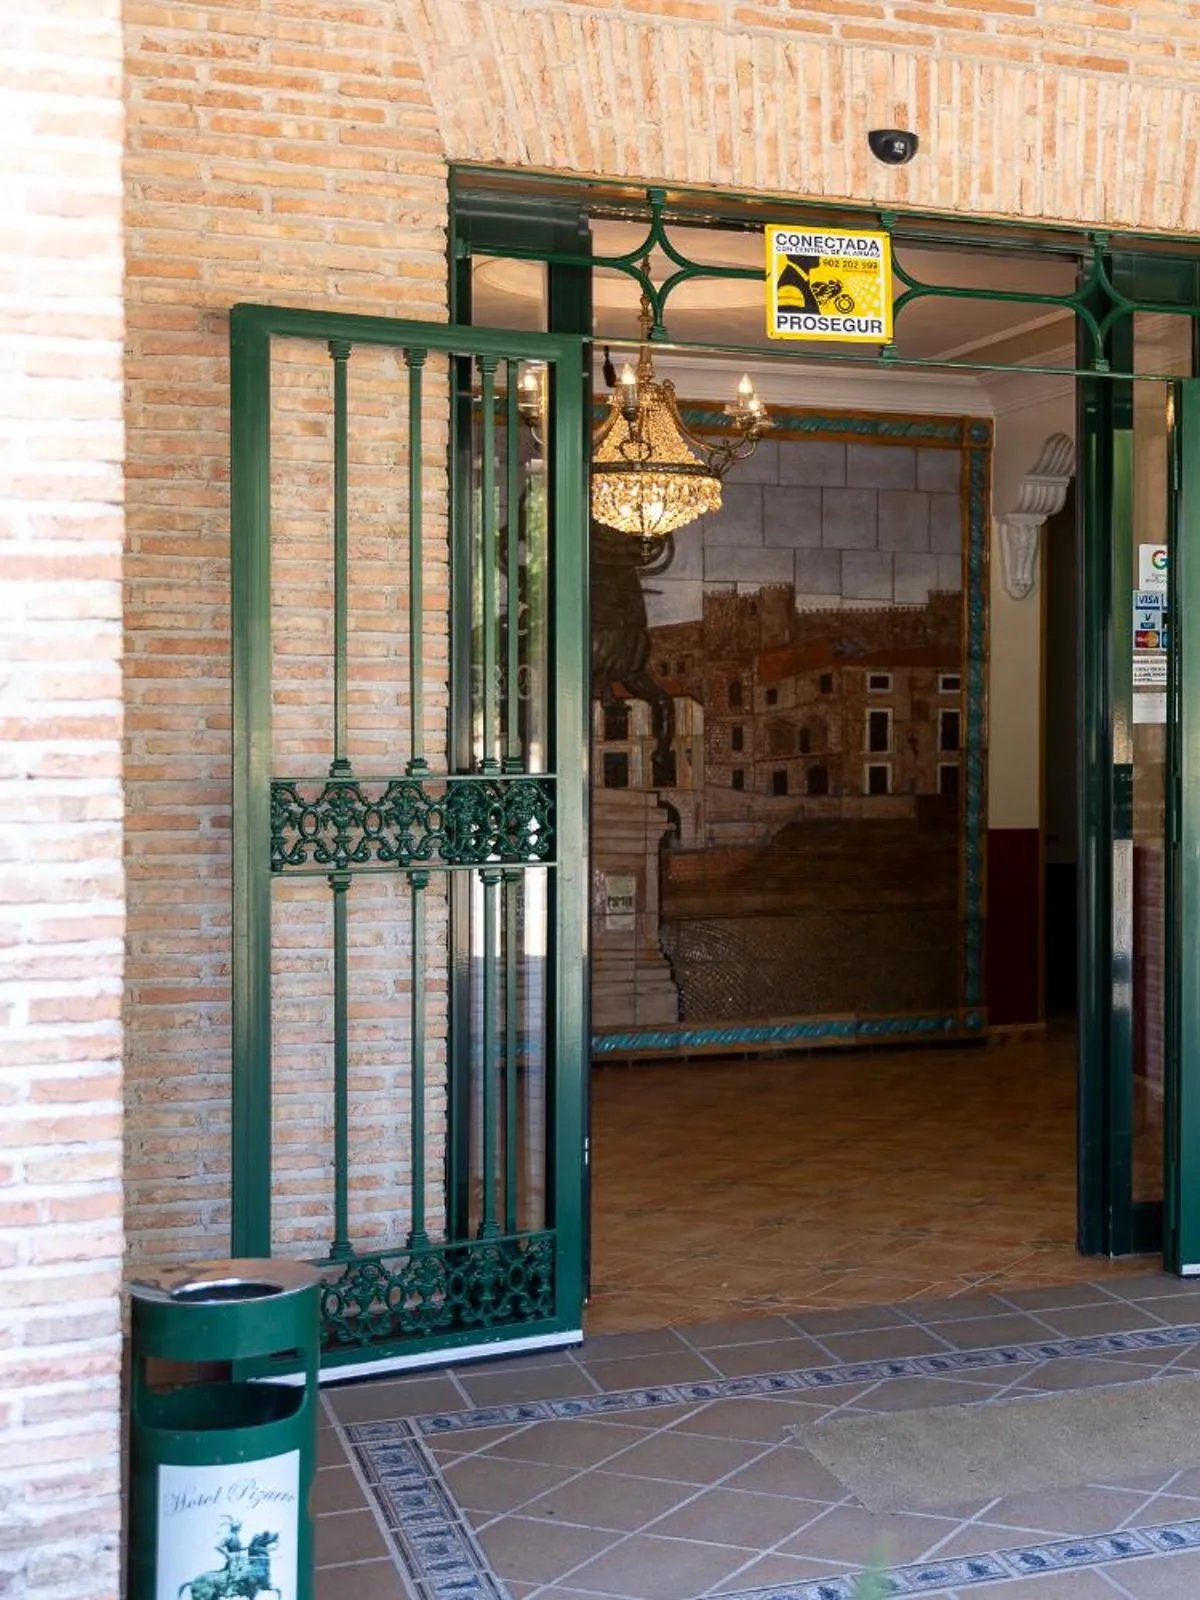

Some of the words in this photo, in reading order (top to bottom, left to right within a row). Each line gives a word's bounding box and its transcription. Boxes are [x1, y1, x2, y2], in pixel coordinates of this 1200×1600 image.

[776, 233, 880, 252] CONECTADA
[795, 247, 829, 255] CENTRAL
[776, 315, 883, 333] PROSEGUR
[1139, 595, 1159, 604] VISA
[163, 1486, 223, 1516] Hotel
[226, 1479, 295, 1510] Pizarro
